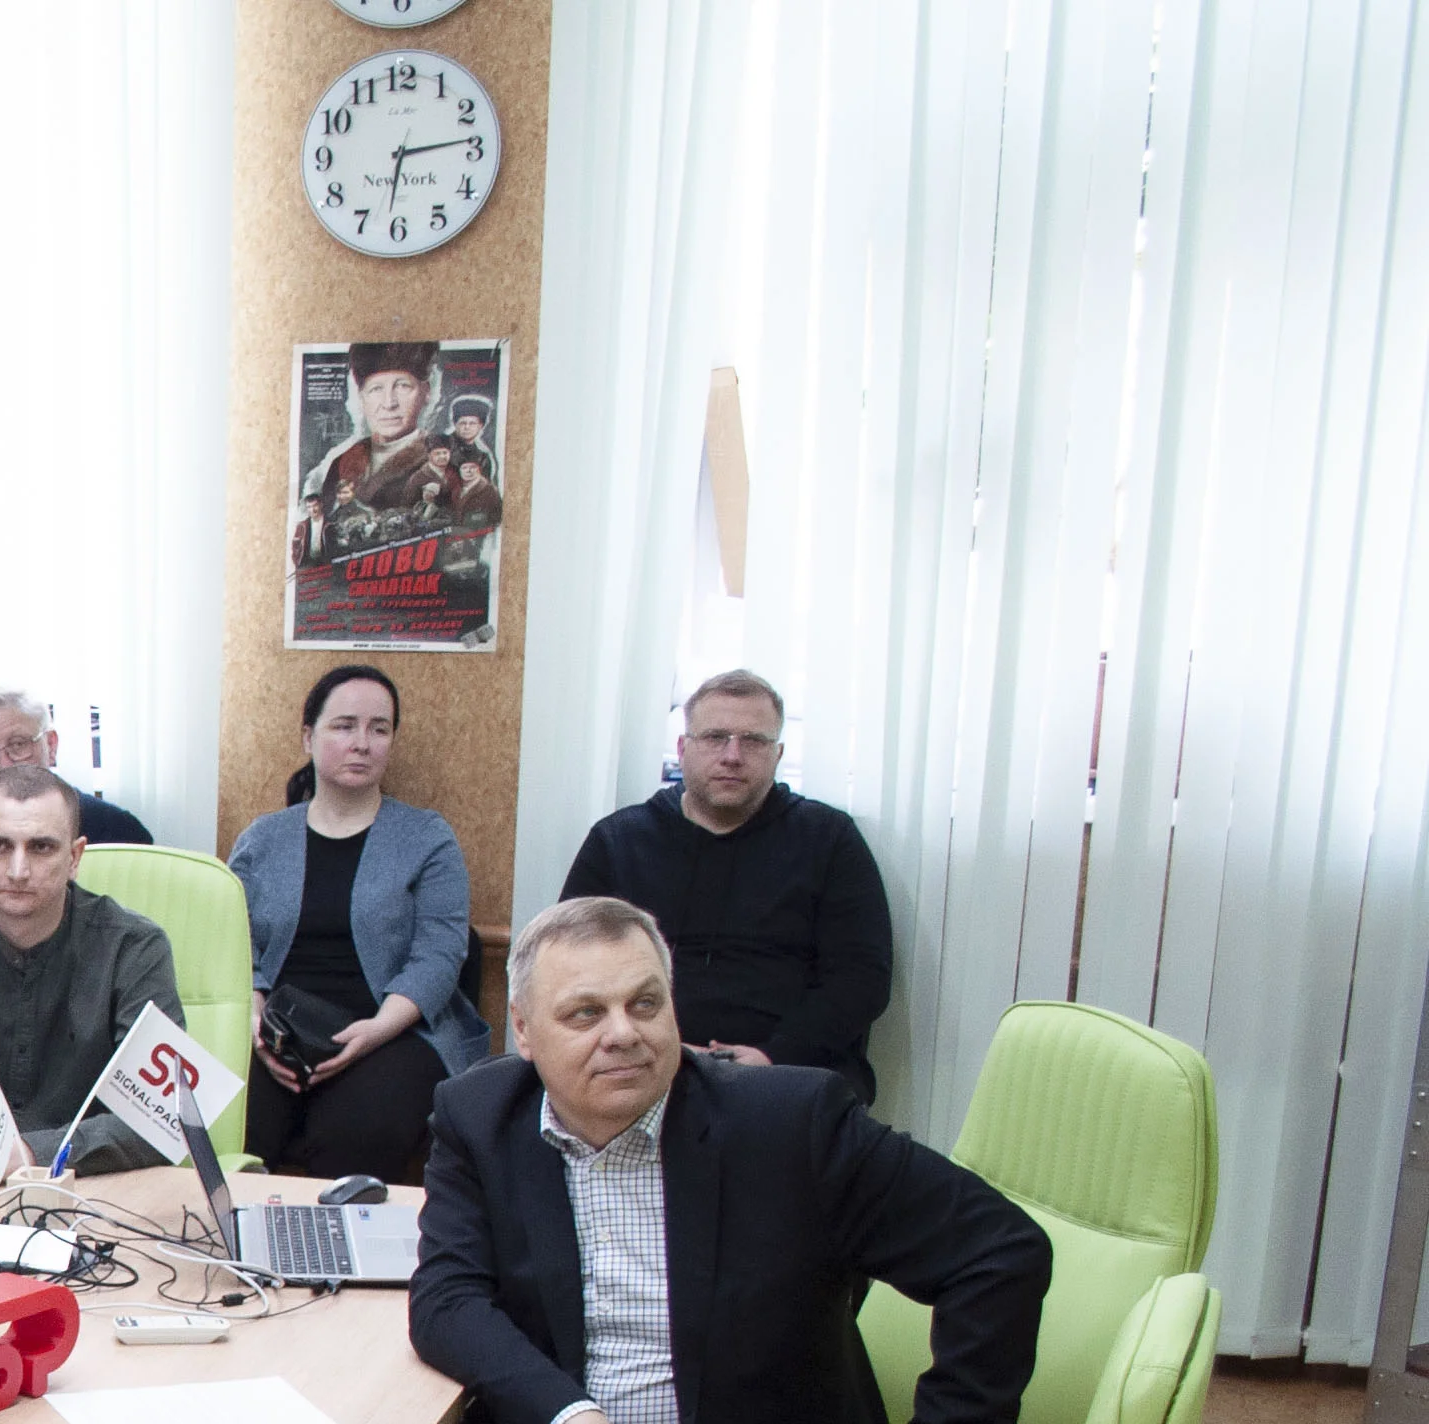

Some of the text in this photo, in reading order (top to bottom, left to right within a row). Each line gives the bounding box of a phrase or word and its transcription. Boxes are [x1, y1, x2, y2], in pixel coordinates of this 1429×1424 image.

[349, 78, 377, 105] 11
[388, 64, 417, 93] 12
[436, 72, 448, 98] 1
[322, 107, 352, 136] 10
[457, 98, 476, 125] 2
[315, 145, 332, 172] 9
[465, 135, 484, 162] 3
[363, 171, 437, 188] New York
[456, 173, 477, 200] 4
[326, 181, 344, 208] 8
[353, 209, 370, 235] 7
[390, 216, 408, 243] 6
[429, 204, 447, 231] 5
[345, 539, 438, 580] СЛОВО
[113, 1069, 182, 1132] SIGNAL-PAC
